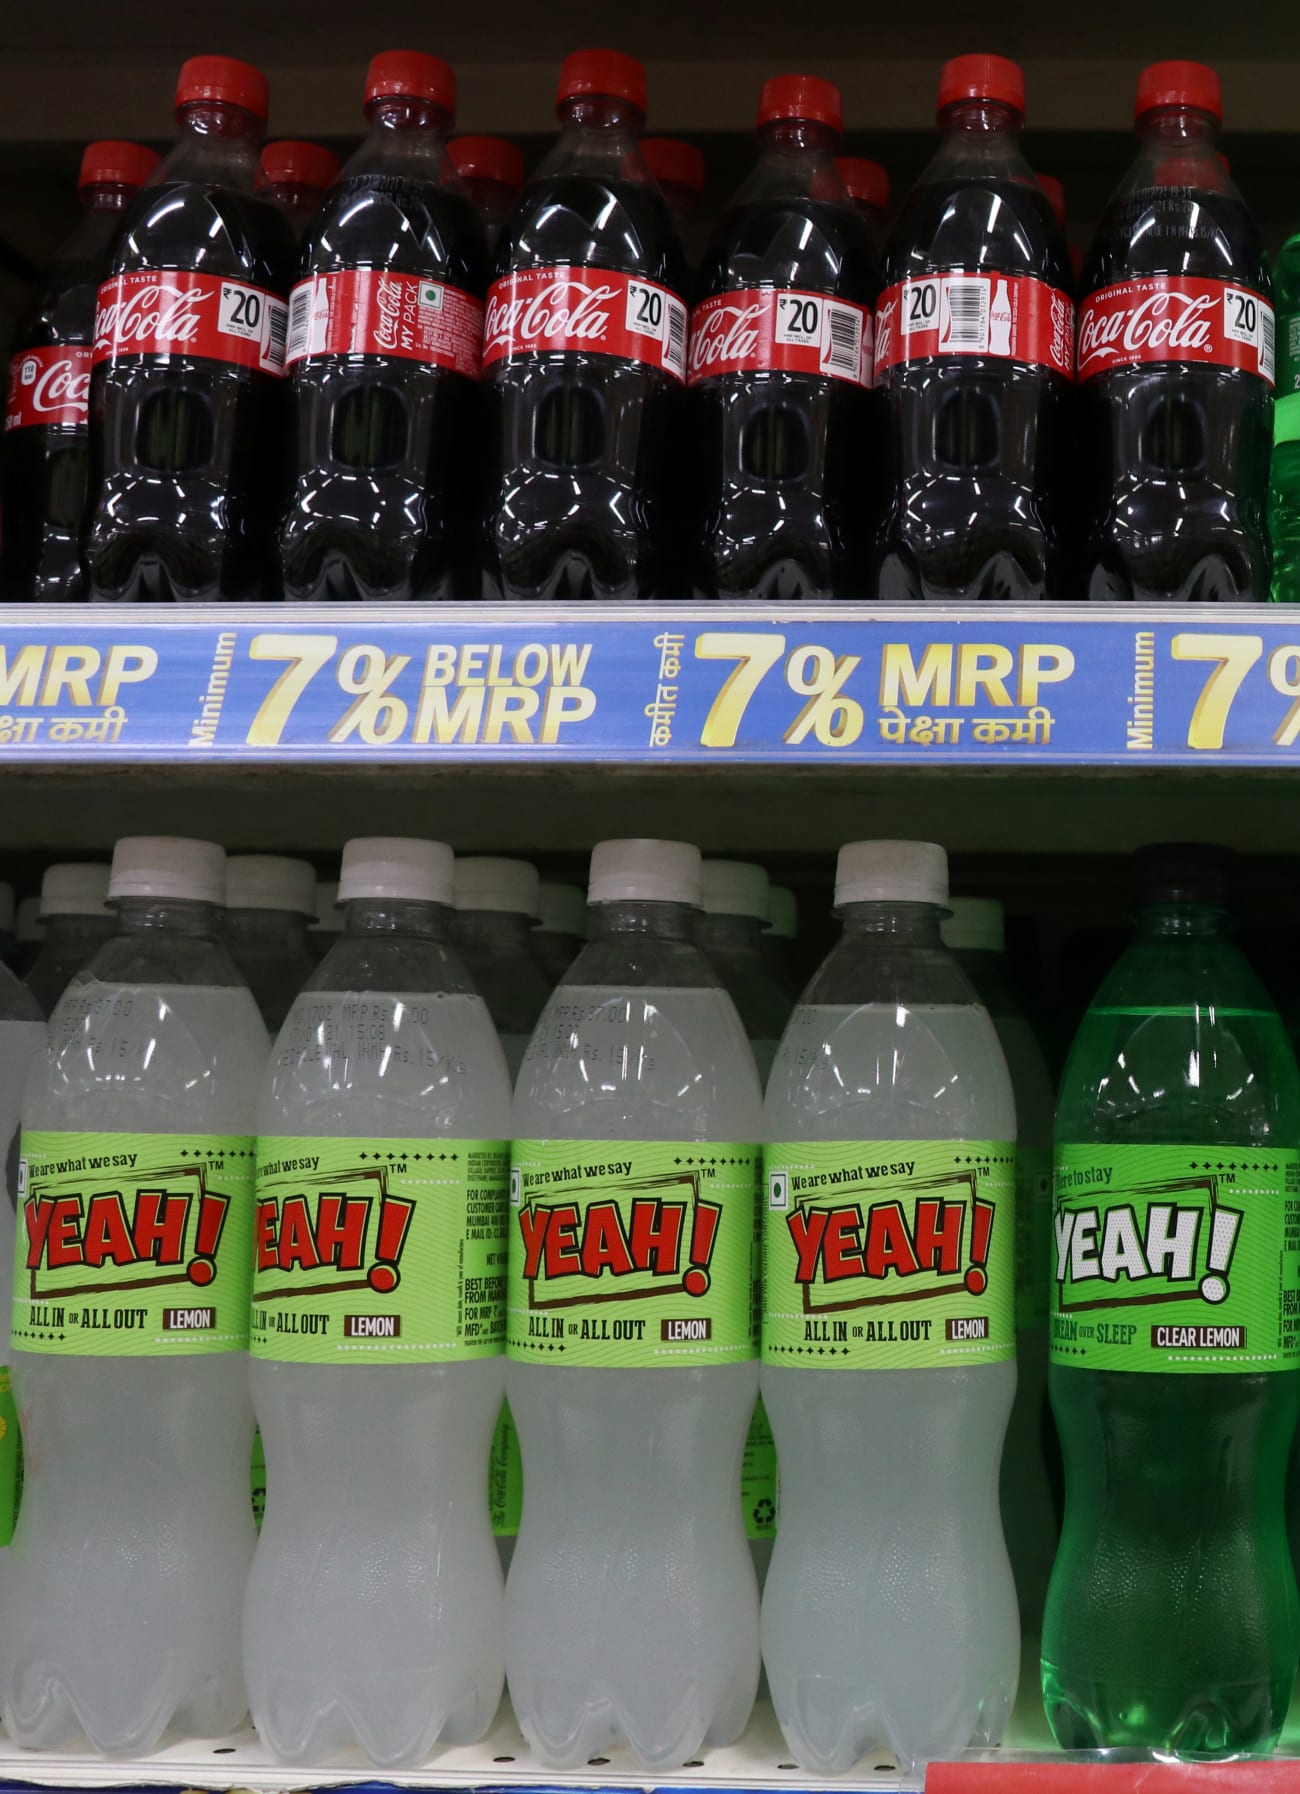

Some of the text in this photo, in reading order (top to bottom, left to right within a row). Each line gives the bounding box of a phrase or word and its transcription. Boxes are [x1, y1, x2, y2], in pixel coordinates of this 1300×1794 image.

[130, 275, 157, 284] TASTE
[499, 271, 566, 289] ORIGNAL TASTE
[403, 281, 419, 324] PACK
[1095, 282, 1167, 303] ORIGINAL TASTE
[373, 276, 403, 350] Coca-Cola
[702, 299, 722, 311] TASTE
[484, 281, 622, 356] Coca-Cola
[401, 326, 414, 350] MY
[1077, 292, 1222, 370] Coca-Cola
[0, 644, 158, 707] MRP
[422, 644, 592, 687] BELOW
[880, 643, 1075, 708] MRP
[189, 632, 237, 748] Minimum
[1126, 631, 1155, 750] Minimum
[48, 705, 128, 744] कमी
[412, 686, 597, 745] MRP
[878, 705, 1055, 746] पेक्षा कमी
[29, 1153, 138, 1179] We are what we say
[263, 1156, 320, 1177] what we say
[523, 1160, 633, 1187] We are what we say
[791, 1161, 915, 1190] We are what we say
[1074, 1166, 1113, 1186] to stay
[467, 1190, 478, 1201] FOR
[24, 1189, 232, 1287] YEAH!
[471, 1228, 486, 1240] MAIL
[518, 1197, 723, 1297] YEAH!
[785, 1197, 996, 1296] YEAH!
[1054, 1202, 1245, 1305] YEAH!
[486, 1253, 496, 1266] NET
[465, 1278, 482, 1290] BEST
[465, 1291, 486, 1304] FROM
[29, 1306, 148, 1329] ALL IN OR ALL OUT
[170, 1309, 211, 1329] LEMON
[259, 1311, 330, 1335] IN ALL OUT
[465, 1306, 492, 1321] FOR MRP
[351, 1317, 395, 1337] LEMON
[528, 1316, 645, 1340] ALL IN OR ALL OUT
[668, 1320, 707, 1340] LEMON
[804, 1320, 932, 1341] ALL IN OR ALL OUT
[951, 1319, 985, 1340] LEMON
[1079, 1324, 1137, 1345] OVER SLEEP
[1157, 1327, 1240, 1347] CLEAR LEMON
